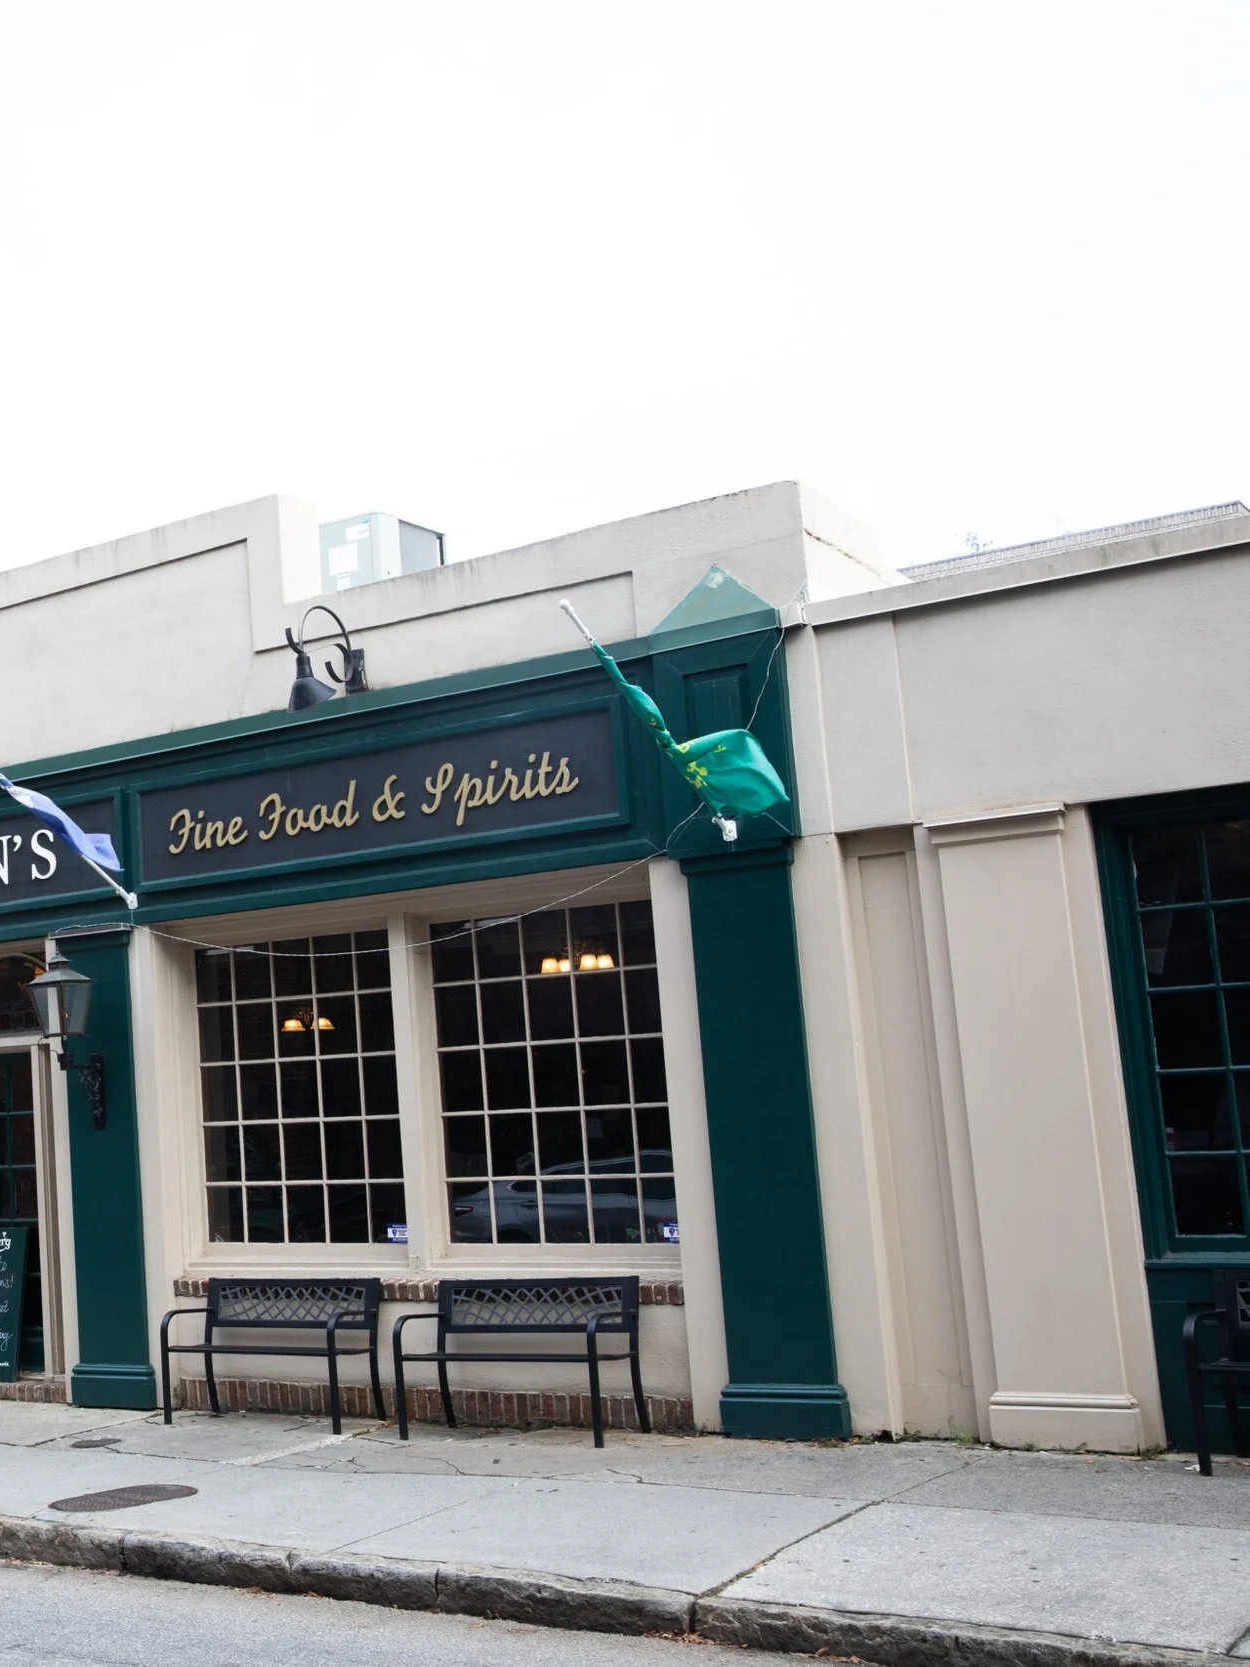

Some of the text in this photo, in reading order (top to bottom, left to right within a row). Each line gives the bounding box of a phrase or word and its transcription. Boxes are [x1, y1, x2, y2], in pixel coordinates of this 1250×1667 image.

[169, 751, 579, 855] Fine Food & Spirits
